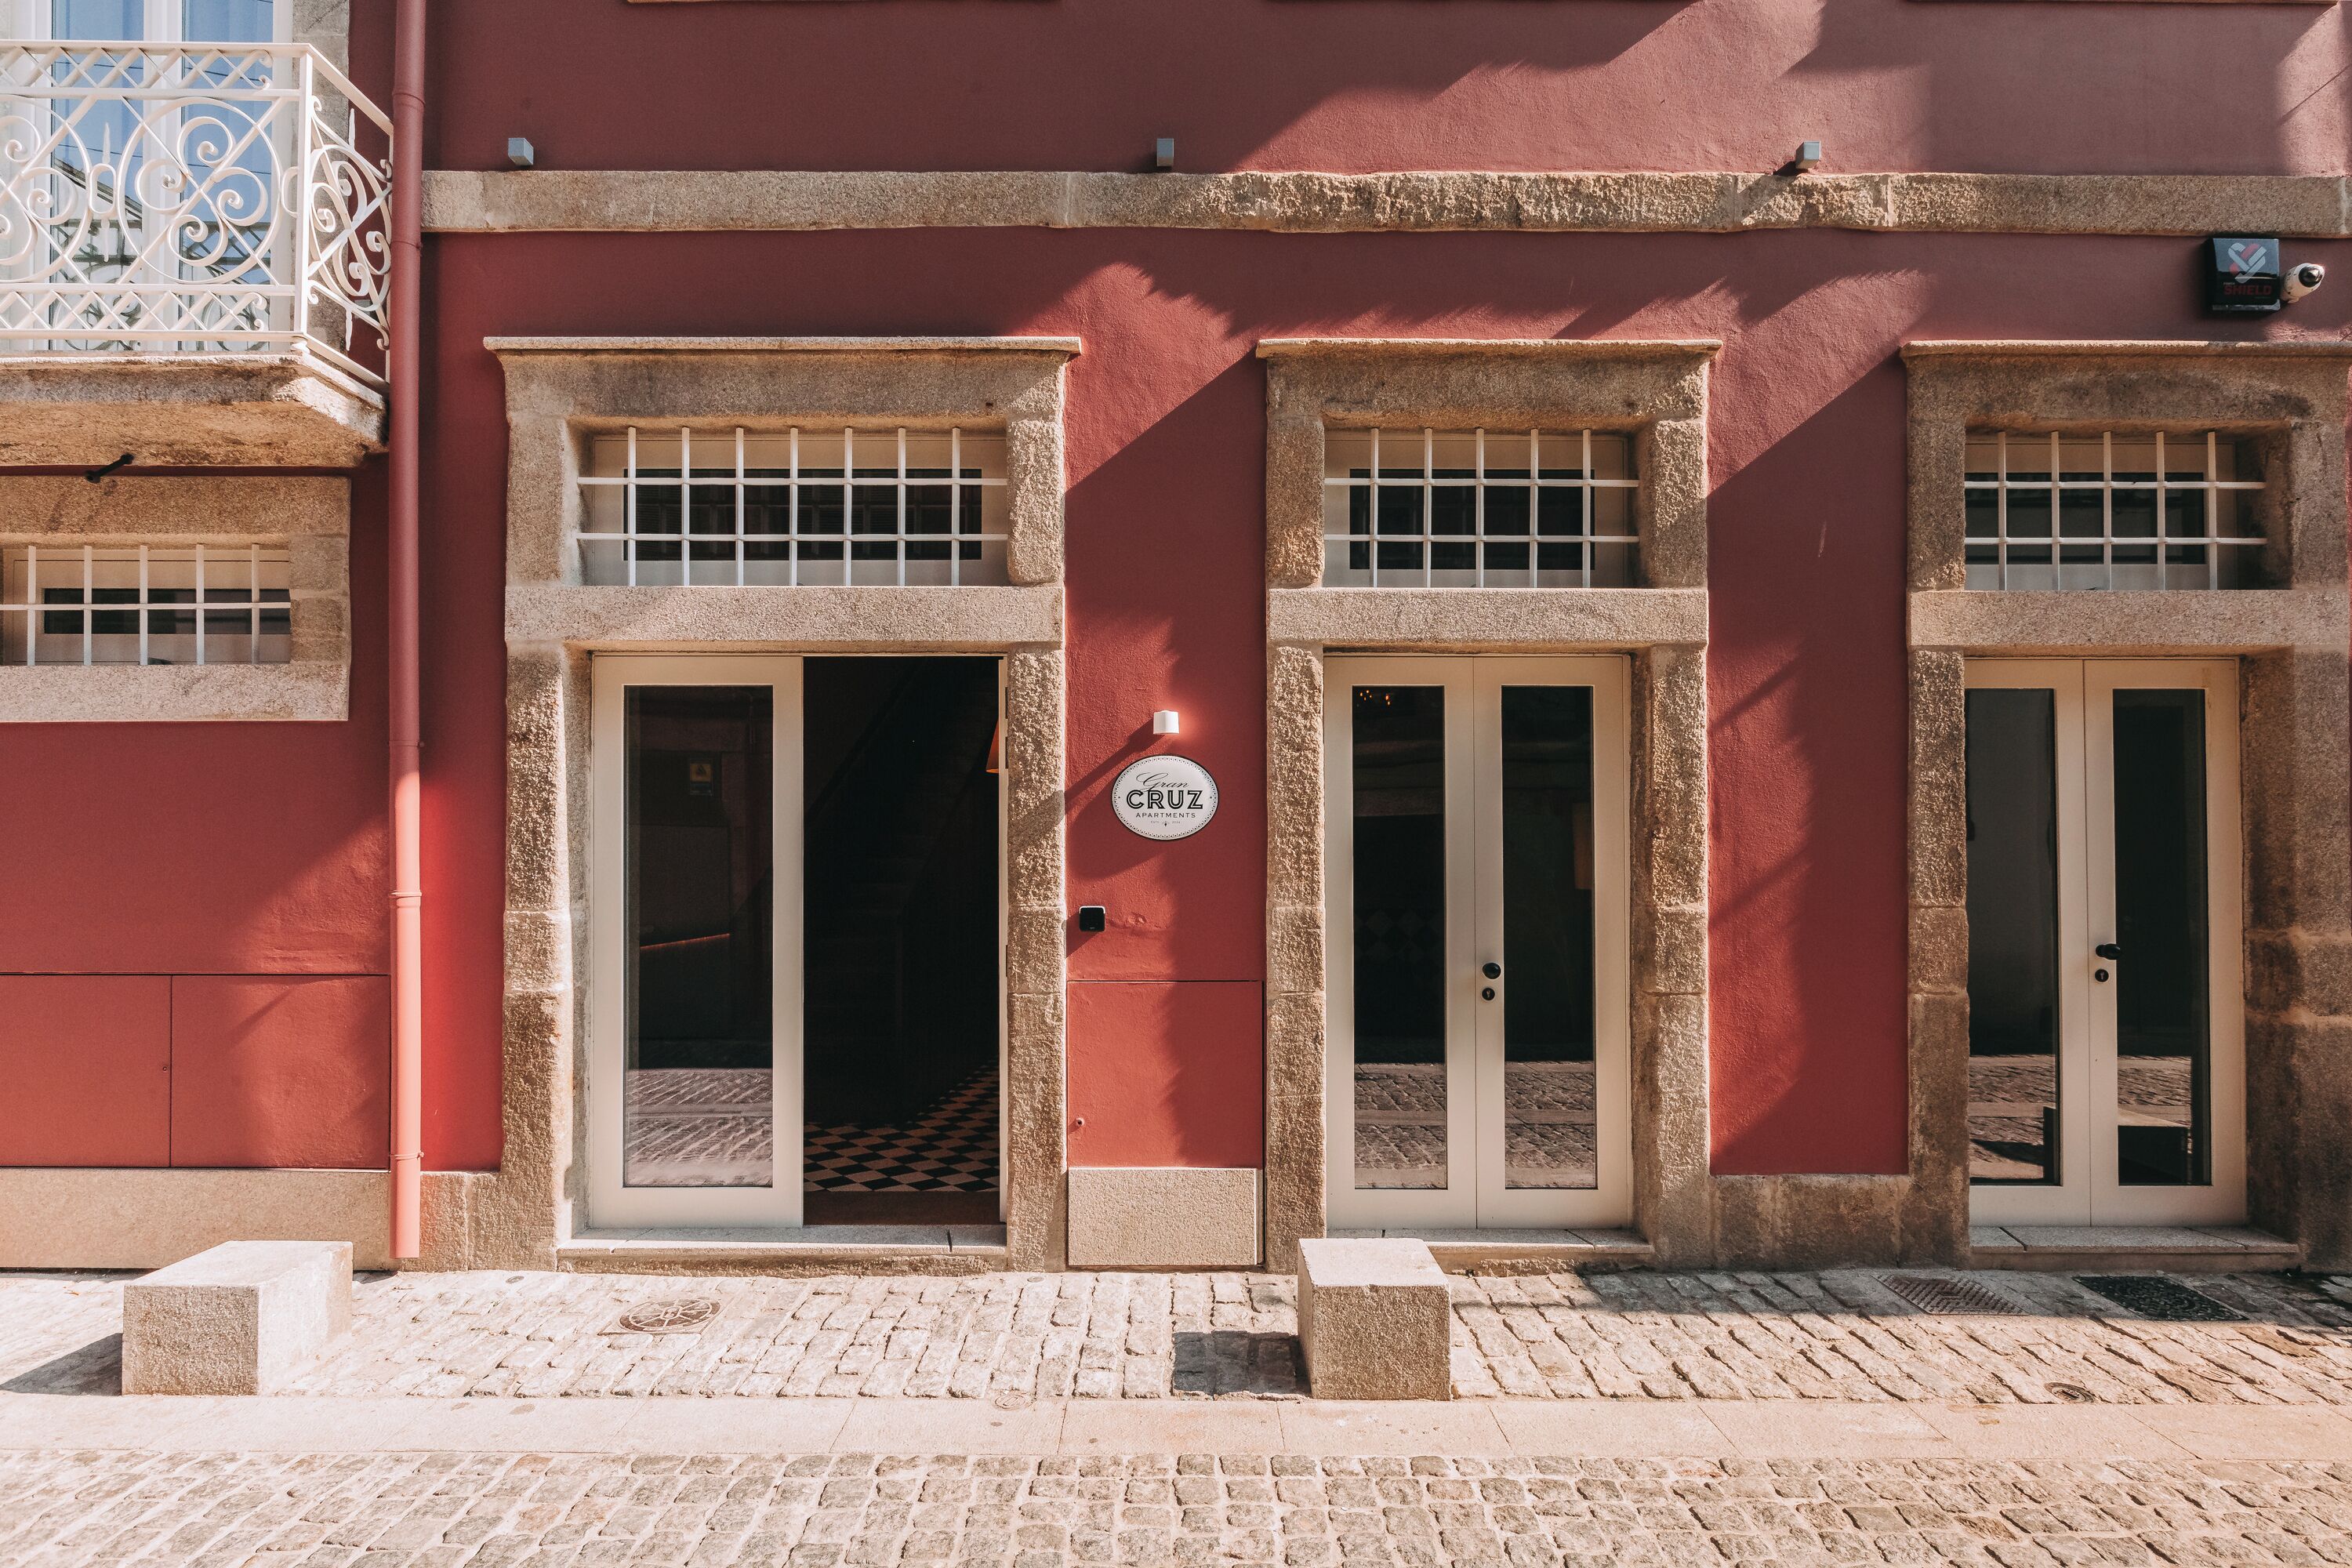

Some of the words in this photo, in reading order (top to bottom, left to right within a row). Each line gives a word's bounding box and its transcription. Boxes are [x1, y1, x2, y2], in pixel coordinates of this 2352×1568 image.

[2223, 285, 2272, 296] SHIELD
[1136, 772, 1189, 792] Gran
[1127, 789, 1203, 809] CRUZ
